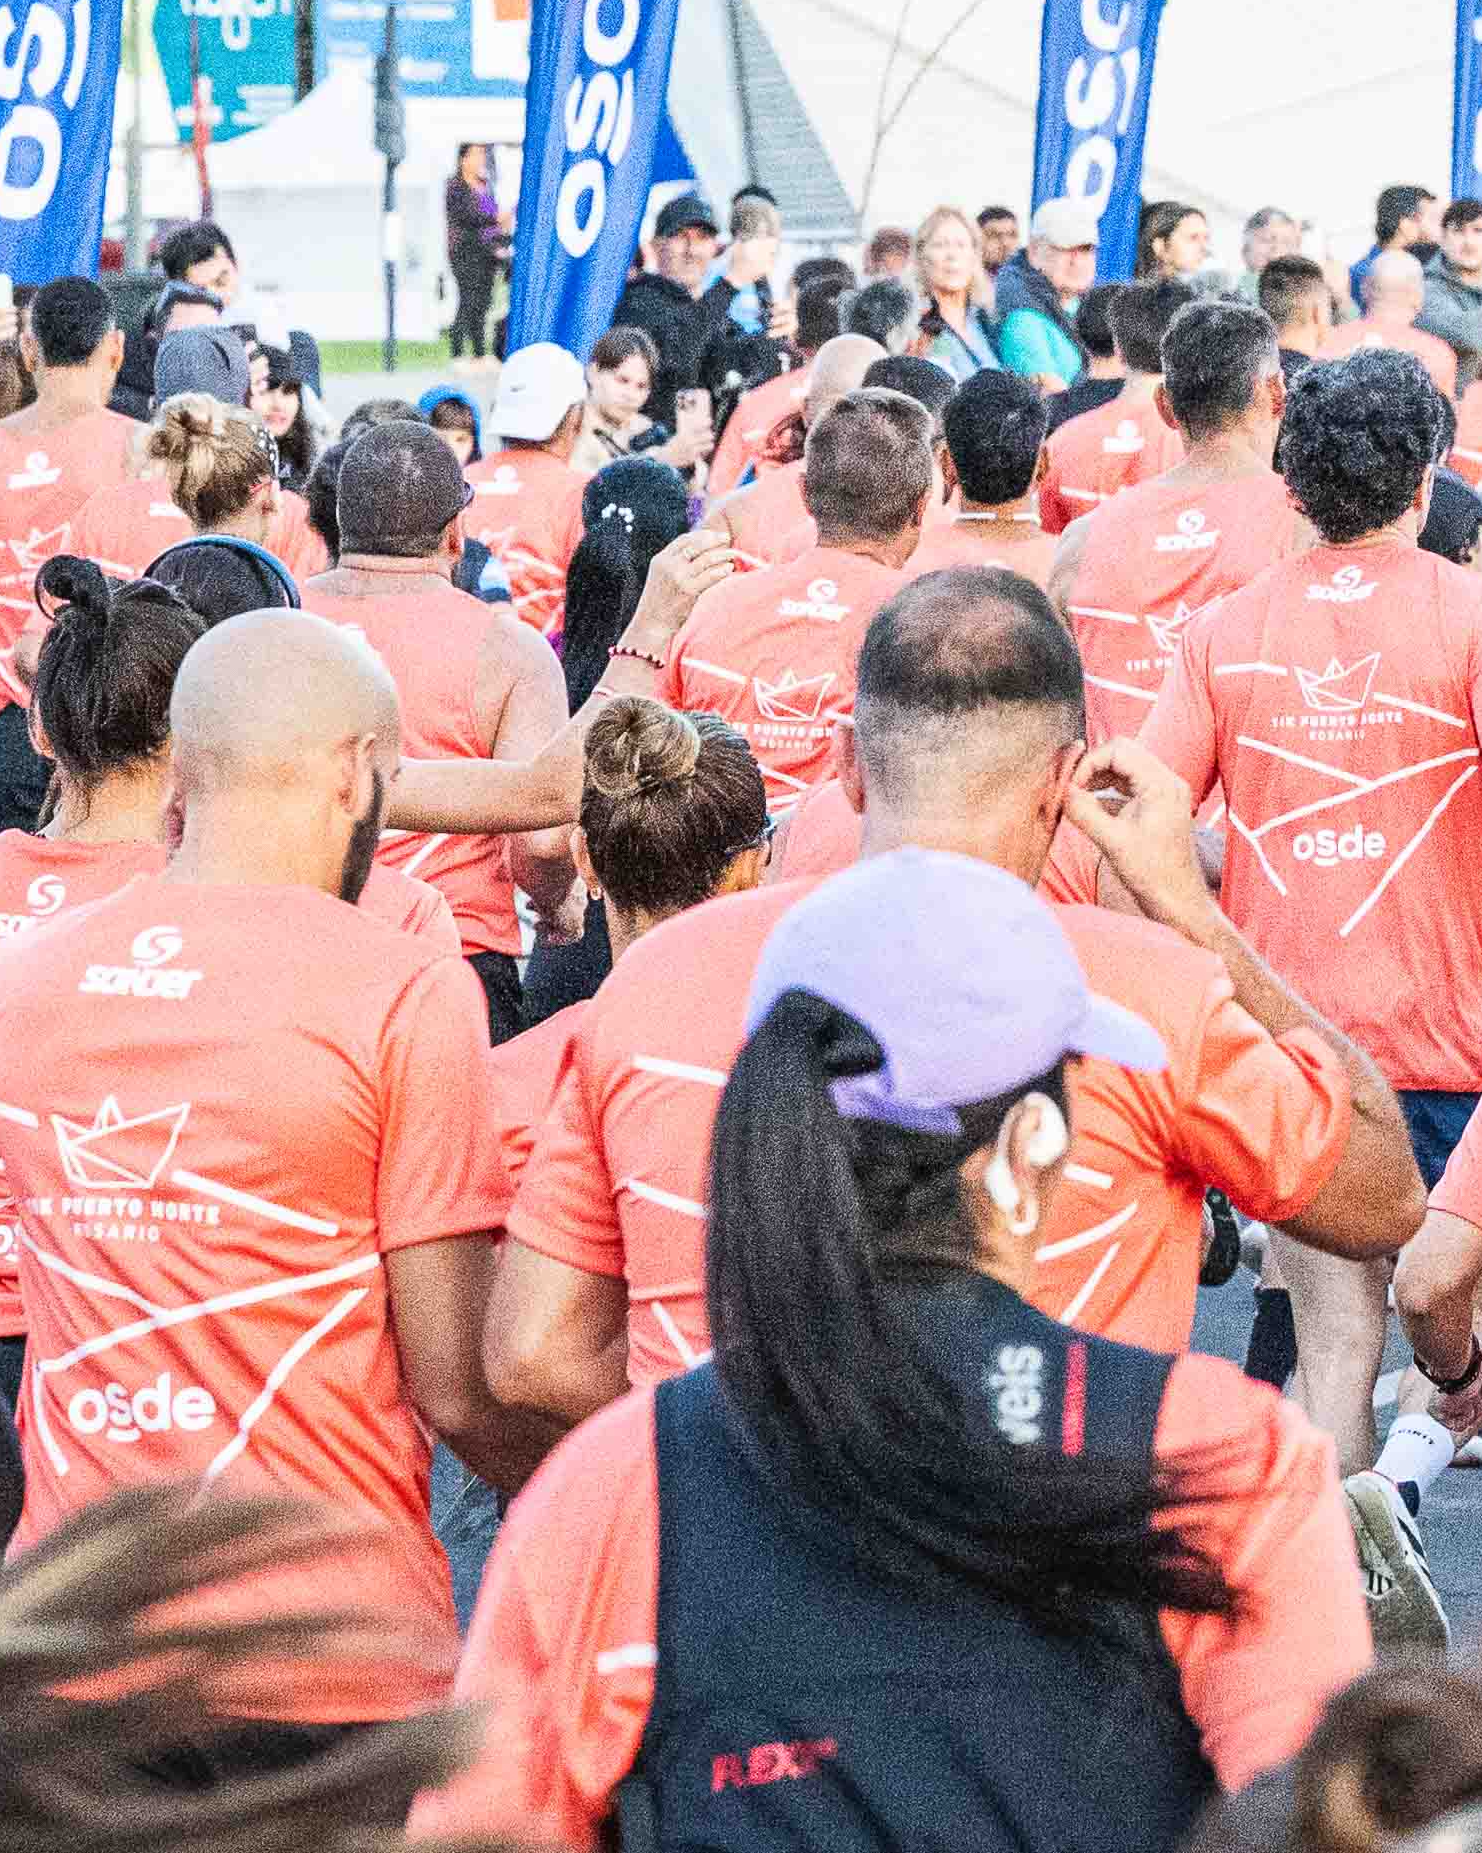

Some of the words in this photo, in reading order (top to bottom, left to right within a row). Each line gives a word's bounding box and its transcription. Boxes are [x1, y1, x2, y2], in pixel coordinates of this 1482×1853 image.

[1293, 824, 1386, 866] osde
[61, 1197, 144, 1219] PUERTO
[67, 1372, 216, 1442] osde
